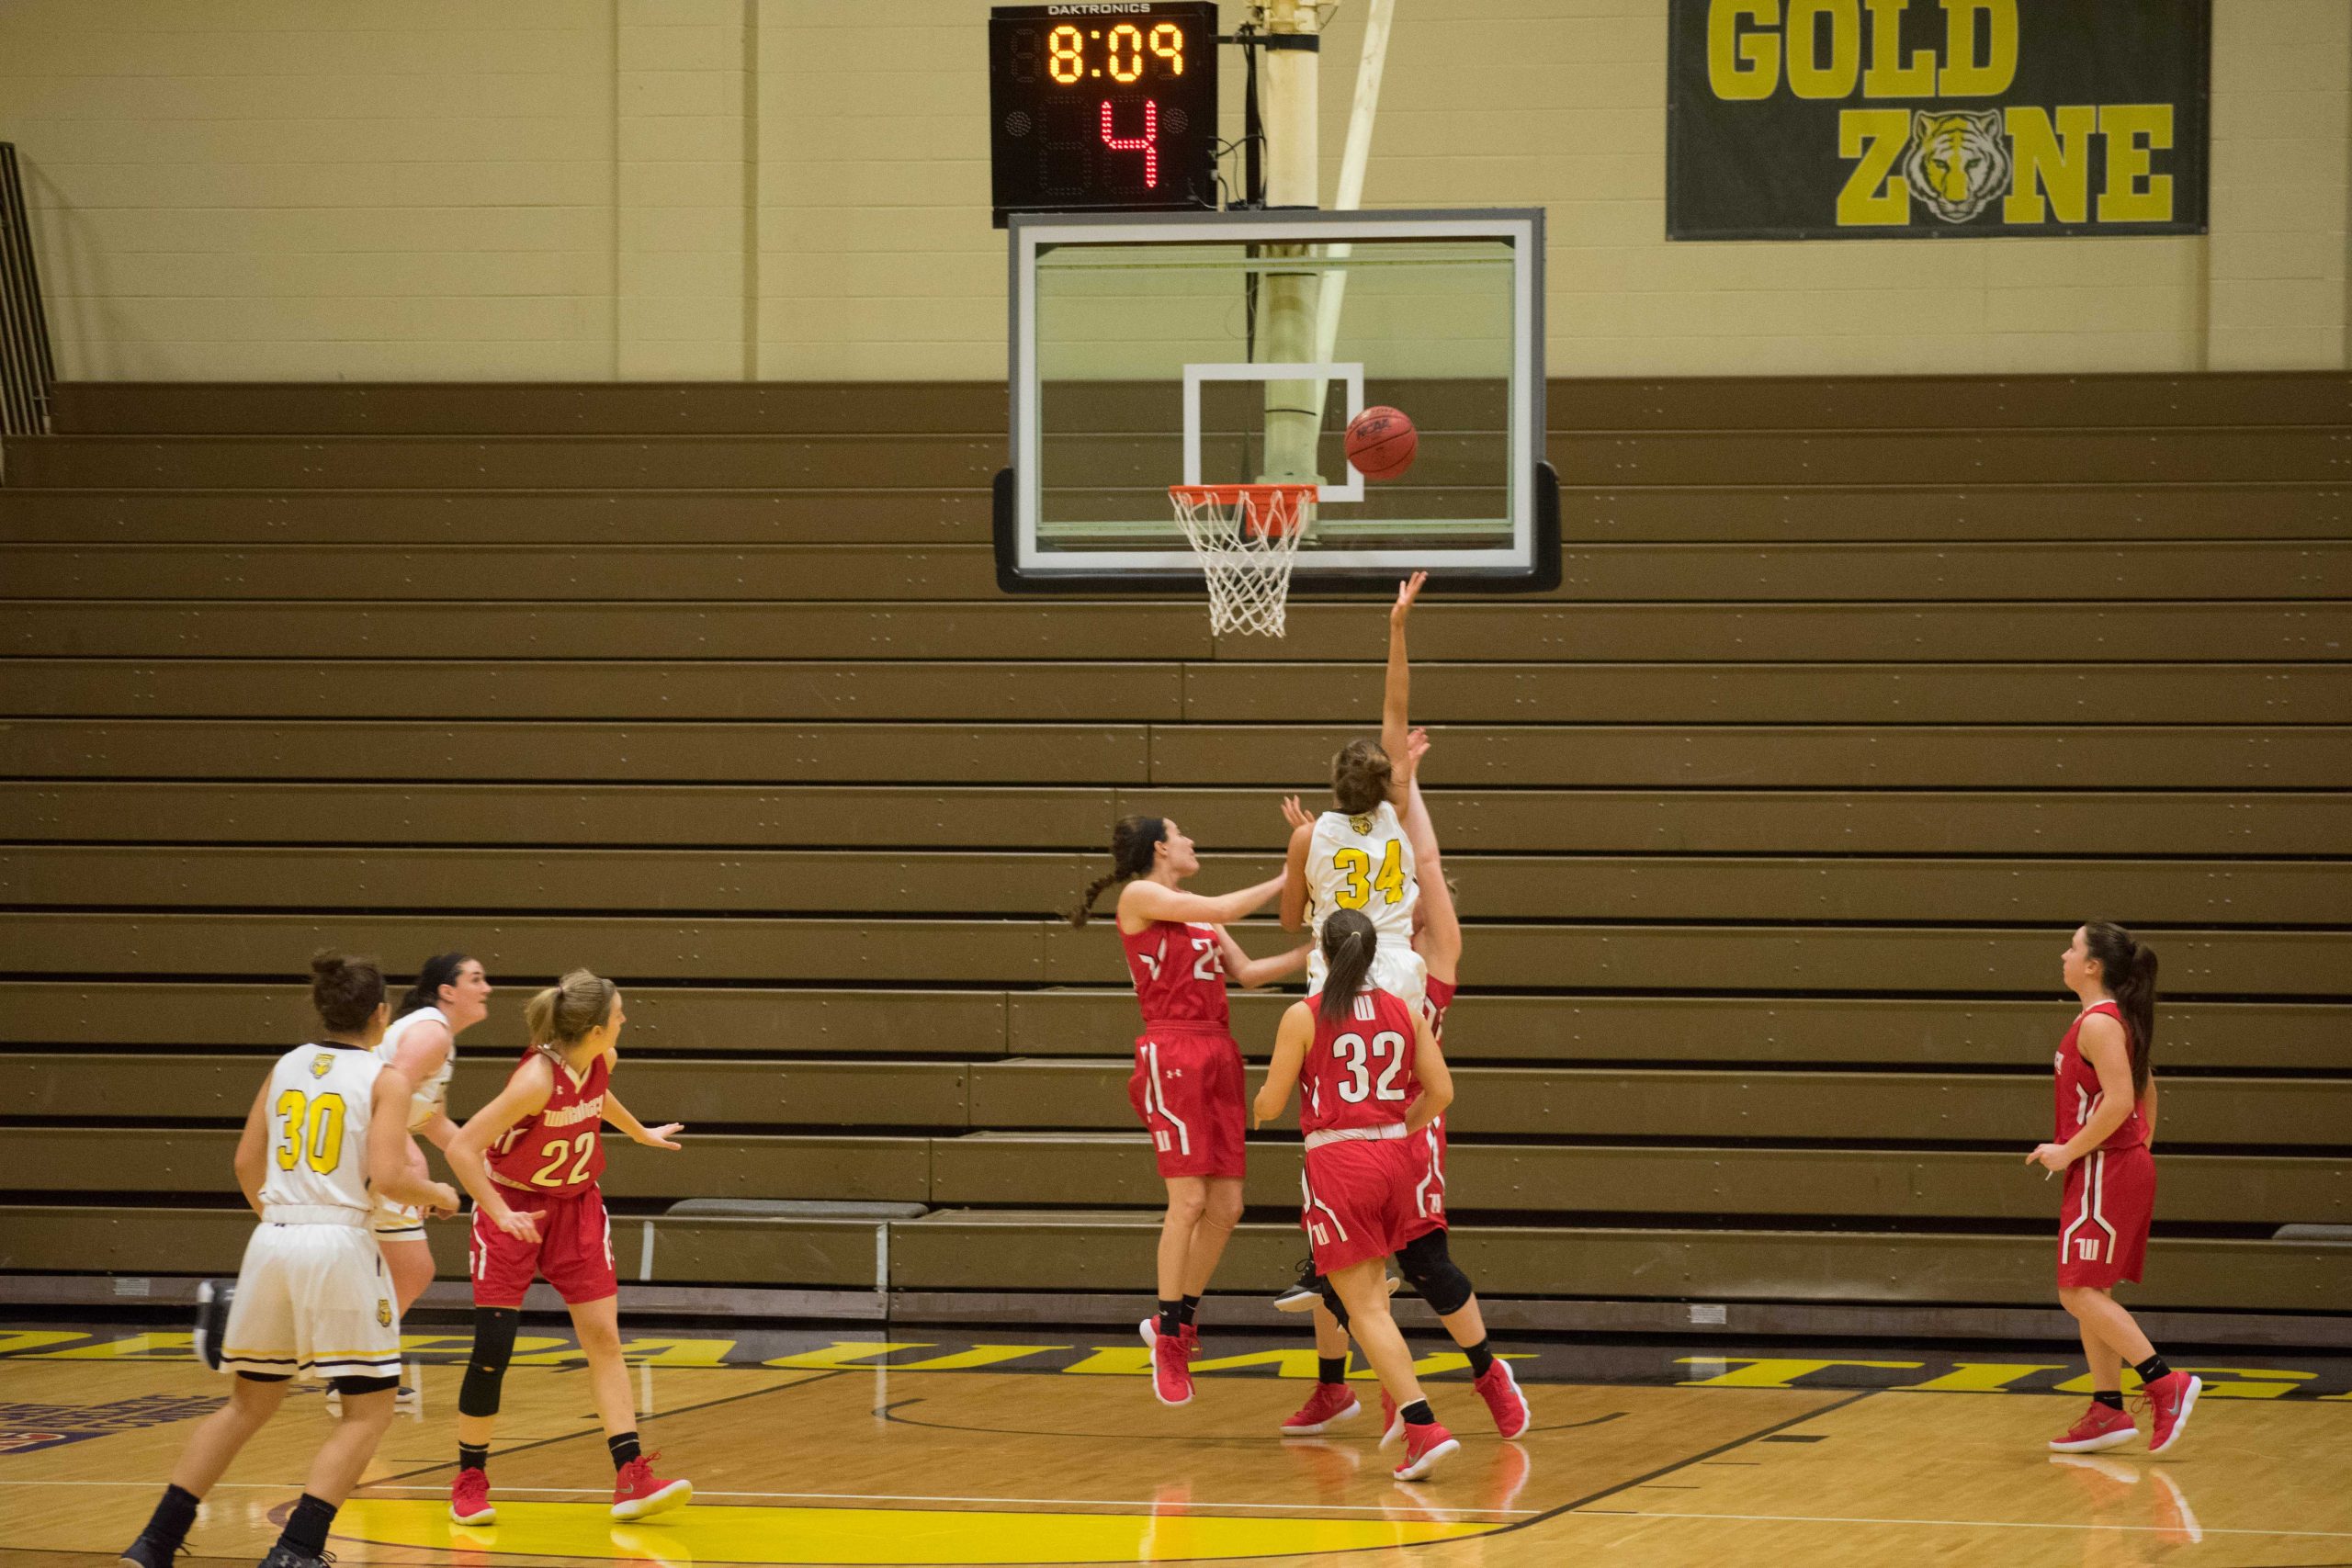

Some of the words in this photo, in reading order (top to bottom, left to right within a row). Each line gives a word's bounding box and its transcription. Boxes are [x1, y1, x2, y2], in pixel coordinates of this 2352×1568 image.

[1047, 3, 1151, 16] DAKTRONICS
[1048, 22, 1183, 84] 8:09
[1707, 0, 2018, 100] GOLD
[1100, 98, 1158, 188] 4
[1836, 103, 2174, 226] ZNE
[1332, 839, 1407, 910] 34
[1332, 1030, 1407, 1103] 32
[276, 1089, 345, 1176] 30
[530, 1131, 595, 1188] 22
